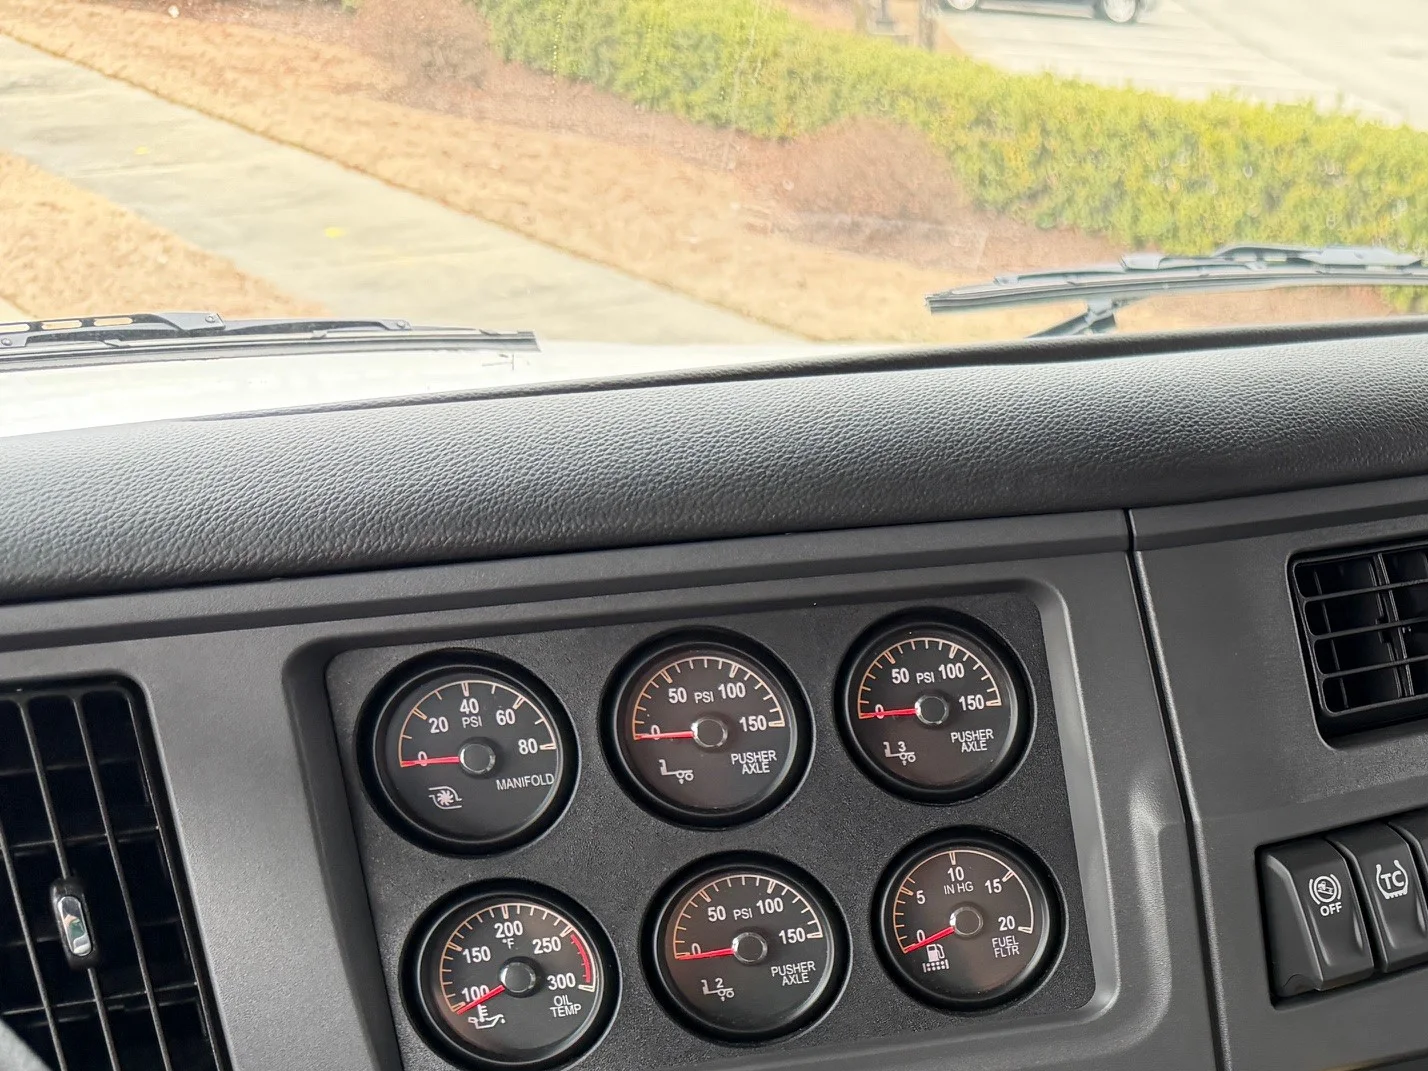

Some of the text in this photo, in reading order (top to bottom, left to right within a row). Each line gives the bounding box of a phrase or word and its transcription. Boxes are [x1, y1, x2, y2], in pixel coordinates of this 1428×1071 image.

[892, 668, 910, 684] 50
[916, 672, 935, 684] PSI
[938, 662, 965, 679] 100
[668, 687, 687, 704] 50
[694, 691, 714, 704] PSI
[718, 682, 746, 699] 100
[459, 697, 479, 715] 40
[959, 694, 985, 711] 150
[428, 716, 449, 734] 20
[462, 716, 482, 729] PSI
[495, 709, 516, 726] 60
[739, 715, 767, 732] 150
[950, 728, 994, 743] PUSHER
[517, 739, 538, 755] 80
[961, 740, 988, 753] AXLE
[731, 750, 777, 765] PUSHER
[741, 762, 770, 775] AXLE
[496, 773, 554, 791] MANIFOLD
[947, 866, 964, 882] 10
[1380, 870, 1405, 890] TC
[943, 881, 974, 895] IN HG
[984, 878, 1002, 894] 15
[916, 890, 926, 905] 5
[707, 905, 726, 922] 50
[756, 897, 784, 915] 100
[1320, 902, 1343, 917] OFF
[733, 908, 753, 921] PSI
[494, 920, 524, 939] 200
[997, 915, 1015, 932] 20
[778, 927, 806, 945] 150
[916, 929, 926, 943] 0
[991, 935, 1019, 949] FUEL
[532, 936, 562, 955] 250
[994, 945, 1020, 958] FLTR
[462, 946, 491, 964] 150
[770, 960, 816, 977] PUSHER
[546, 972, 576, 991] 300
[781, 973, 810, 987] AXLE
[553, 995, 573, 1008] OIL
[550, 1004, 582, 1018] TEMP
